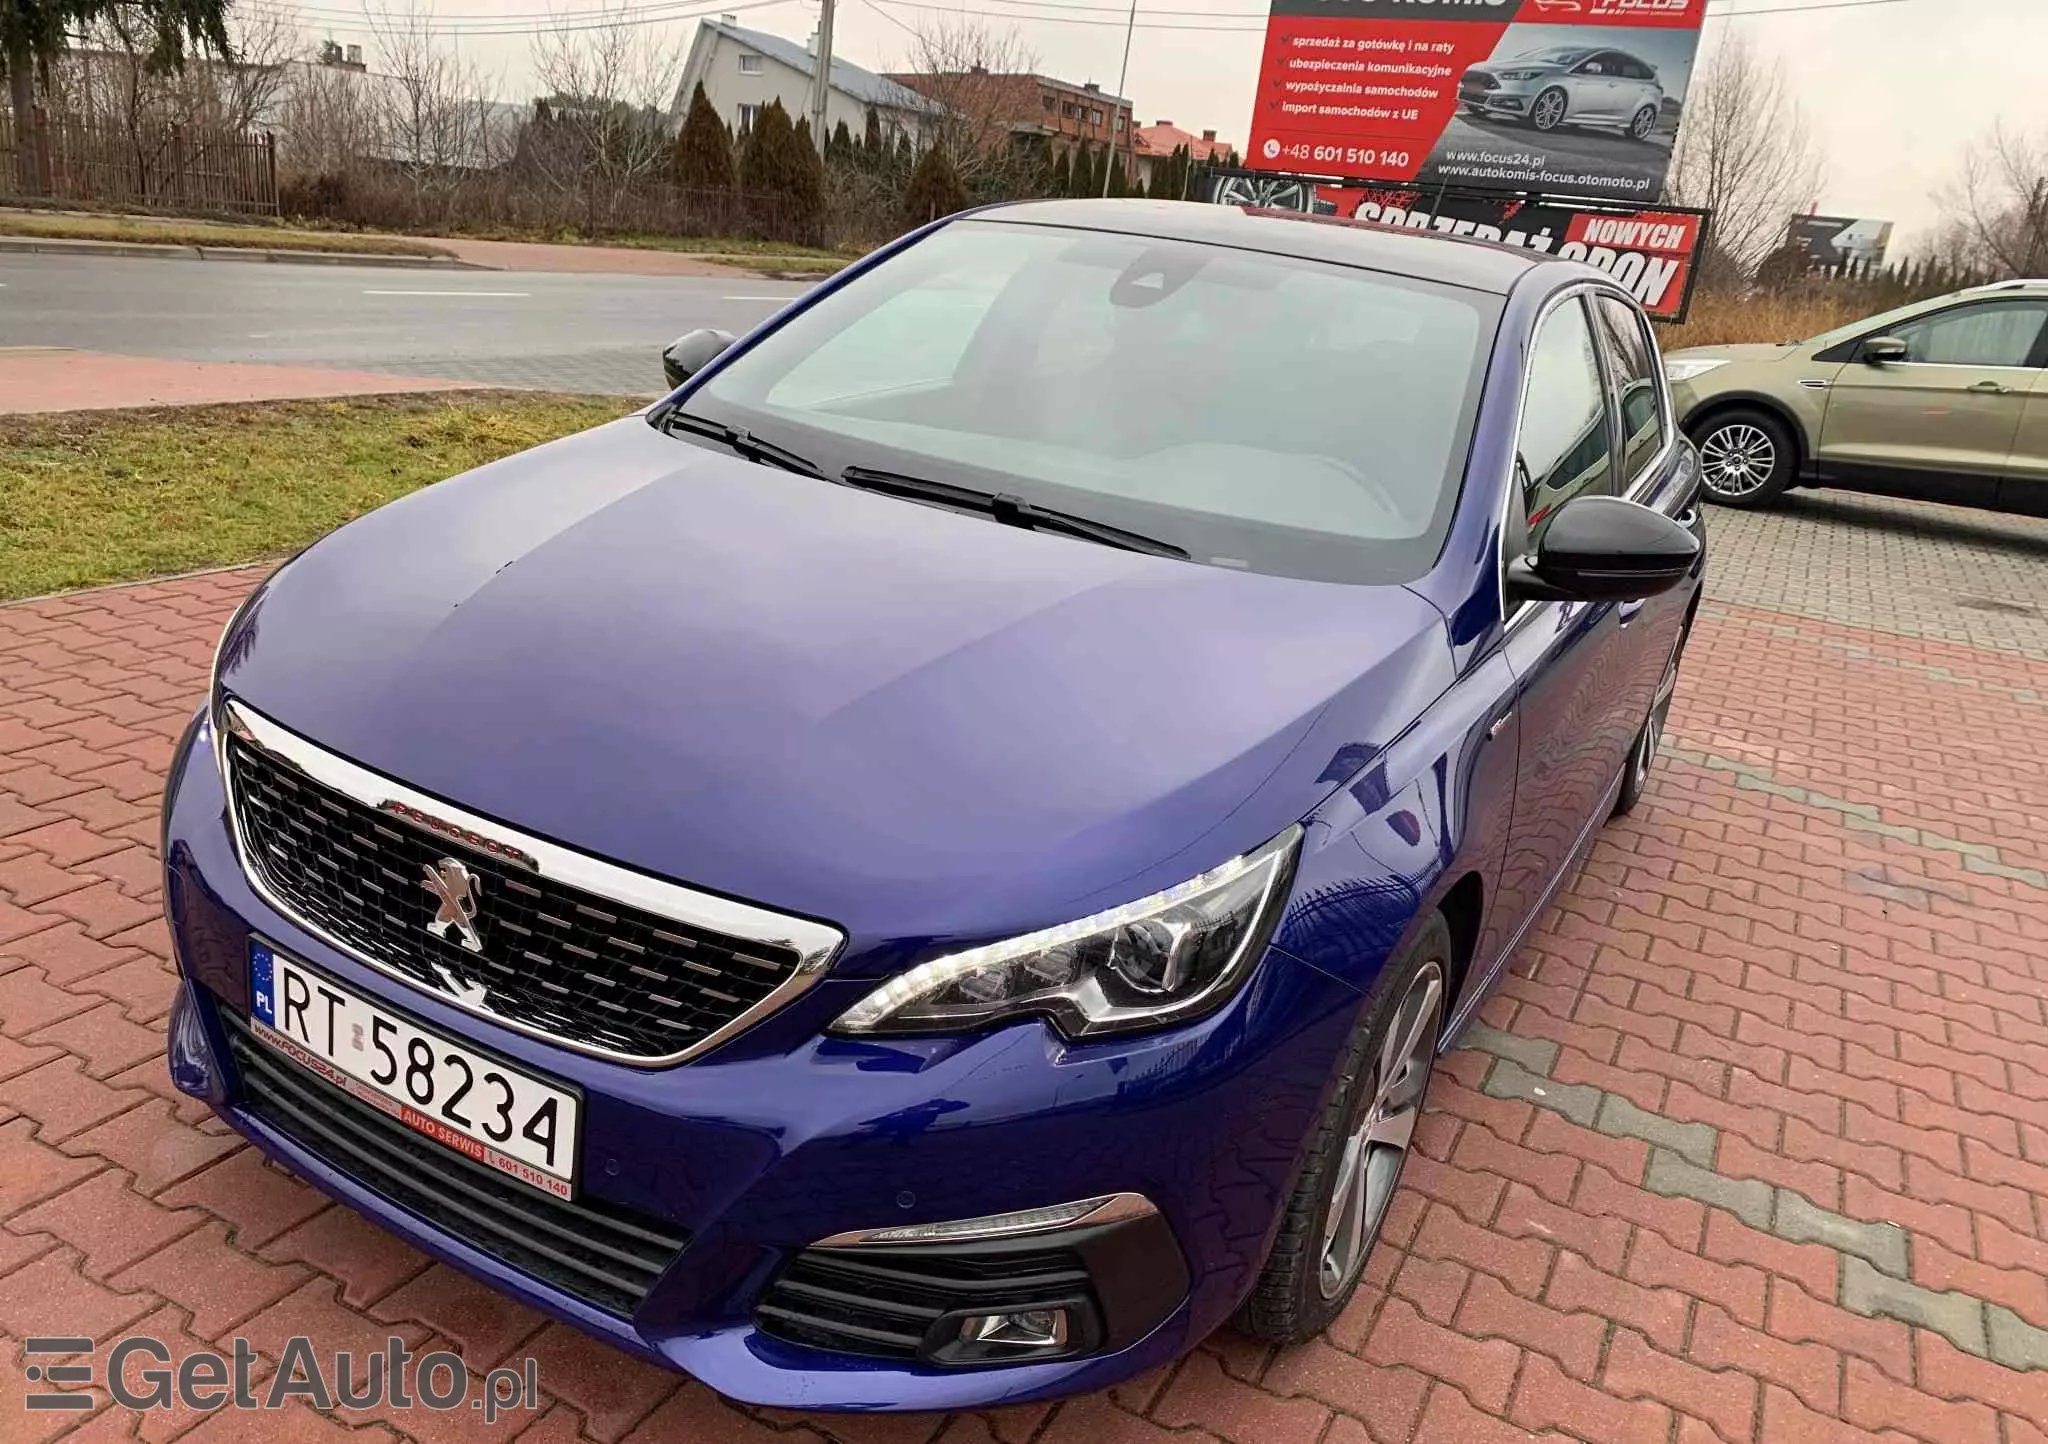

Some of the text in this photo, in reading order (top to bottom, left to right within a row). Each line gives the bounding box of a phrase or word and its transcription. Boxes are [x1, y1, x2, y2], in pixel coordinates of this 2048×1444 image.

[1293, 36, 1341, 49] sprzedaż
[1342, 39, 1355, 49] za
[1357, 38, 1405, 53] gotówkę
[1414, 41, 1429, 52] na
[1430, 41, 1455, 55] raty
[1289, 58, 1452, 77] ubezpieczenia komunikacyjne
[1285, 79, 1438, 99] wypożyczalnia samochodów
[1282, 100, 1418, 121] import samochodów z UE
[1283, 143, 1409, 168] +48 601 510 140
[1446, 150, 1545, 168] www.focus24.pl
[1438, 163, 1650, 192] www.autokomis-focus.otomoto.pl
[1582, 218, 1687, 249] NOWYCH
[256, 990, 273, 1015] PL
[283, 966, 559, 1167] RT 58234
[403, 1109, 483, 1158] AUTO SERWIS
[498, 1157, 568, 1196] 601 510 140
